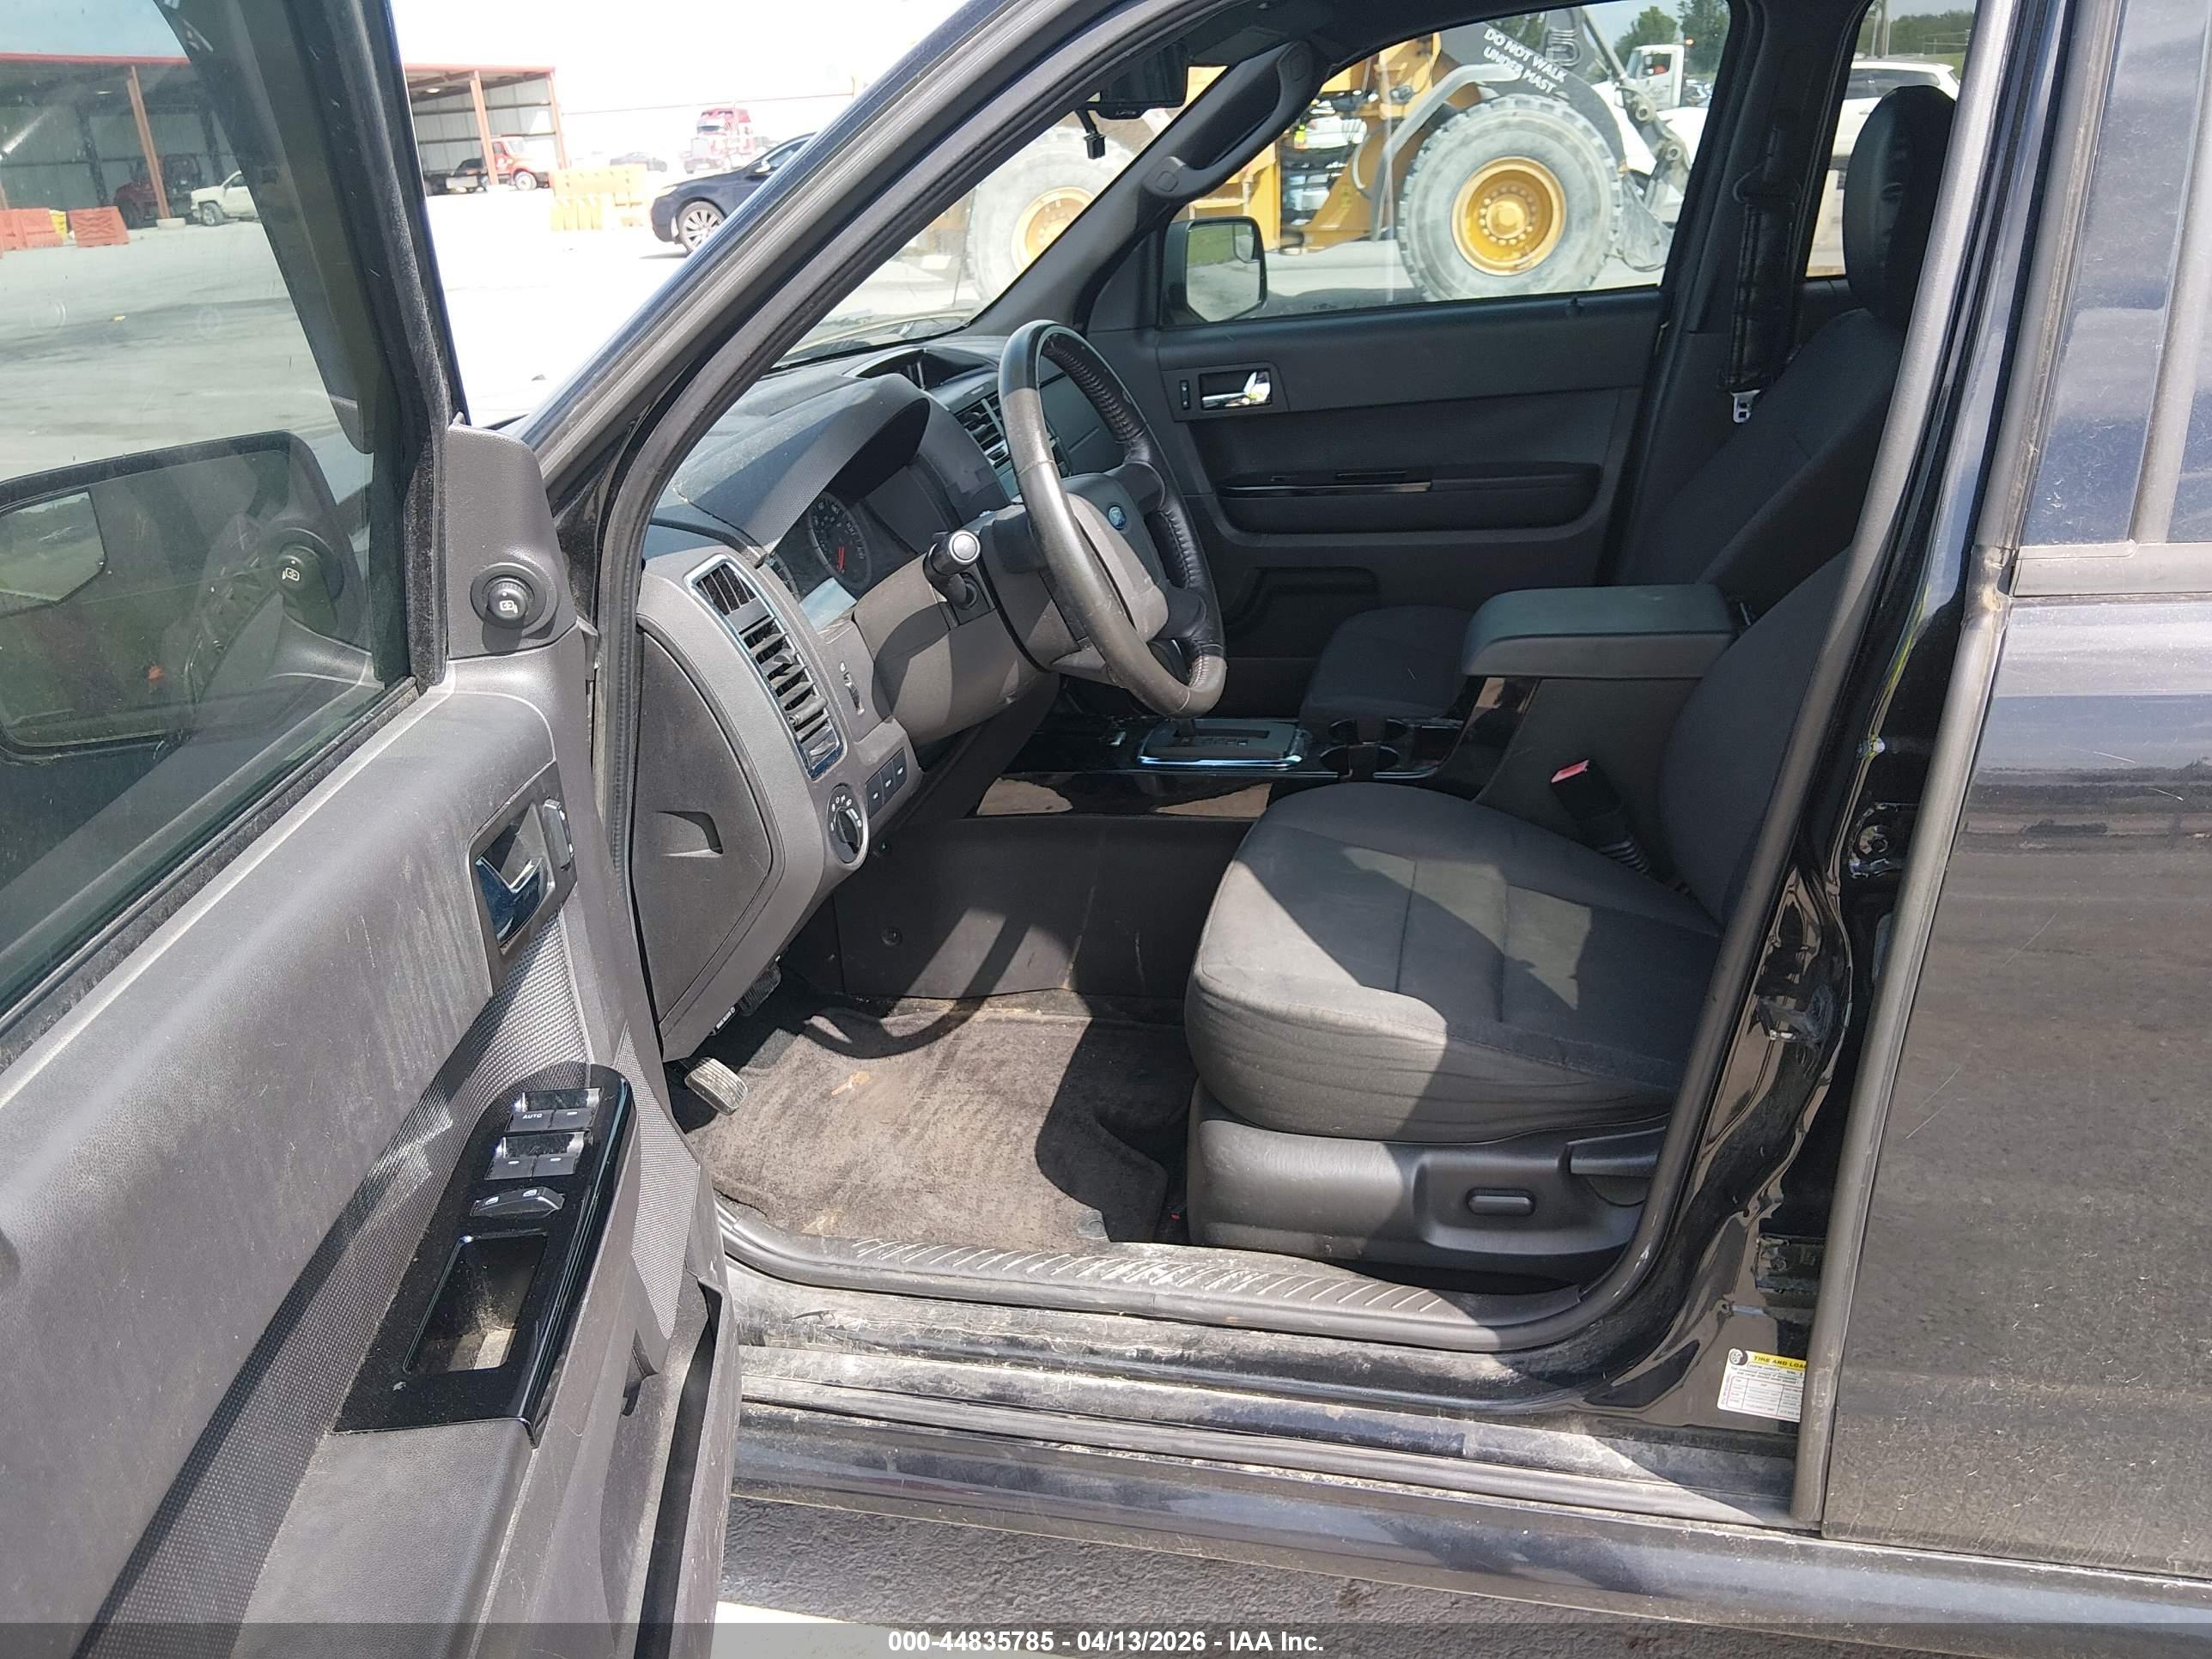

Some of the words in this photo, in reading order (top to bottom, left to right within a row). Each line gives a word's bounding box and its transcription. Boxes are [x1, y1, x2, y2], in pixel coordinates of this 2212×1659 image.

[1484, 28, 1505, 46] DO
[1504, 40, 1532, 62] NOT
[1532, 54, 1568, 83] WALK
[1522, 69, 1557, 94] MAST
